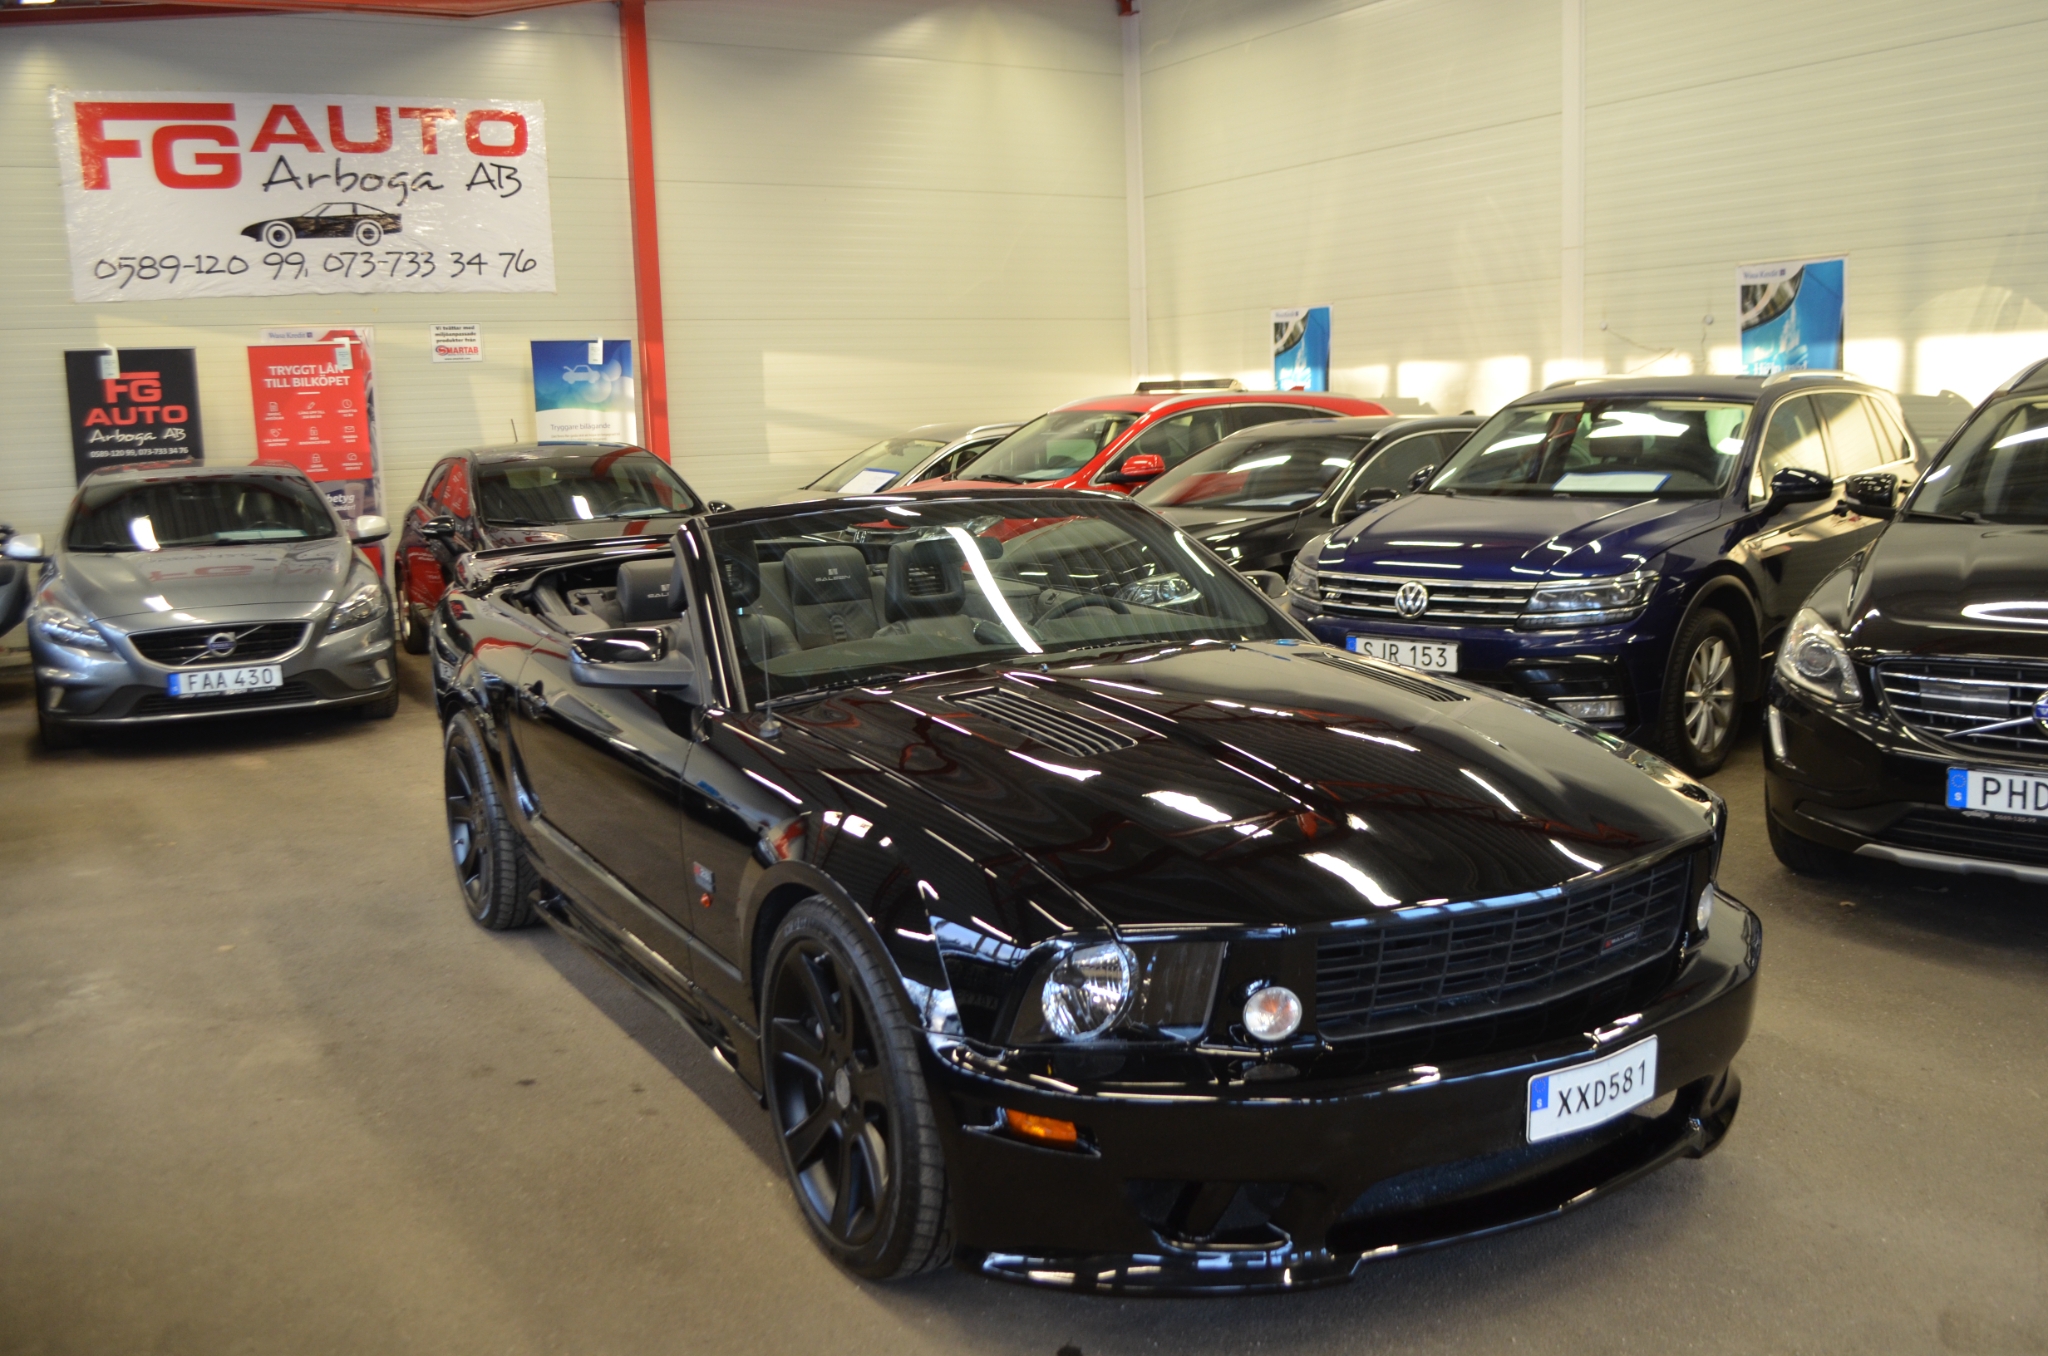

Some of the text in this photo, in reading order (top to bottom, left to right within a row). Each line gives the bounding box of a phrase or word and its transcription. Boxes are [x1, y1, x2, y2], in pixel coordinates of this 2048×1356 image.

[74, 102, 529, 190] FG AUTO
[262, 154, 523, 206] Arboga AB
[94, 249, 537, 290] 0589-120 99, 073-733 34 76
[265, 375, 350, 388] TILL BILKÖPET
[269, 365, 316, 375] TRYGGT
[105, 371, 162, 403] FG
[84, 405, 188, 426] AUTO
[551, 422, 610, 431] Tryggare bilägande
[88, 428, 186, 446] Arboga AB
[1409, 645, 1448, 668] 153
[188, 668, 274, 691] FAA 430
[1981, 776, 2048, 811] PHD
[1556, 1059, 1646, 1117] XXD581
